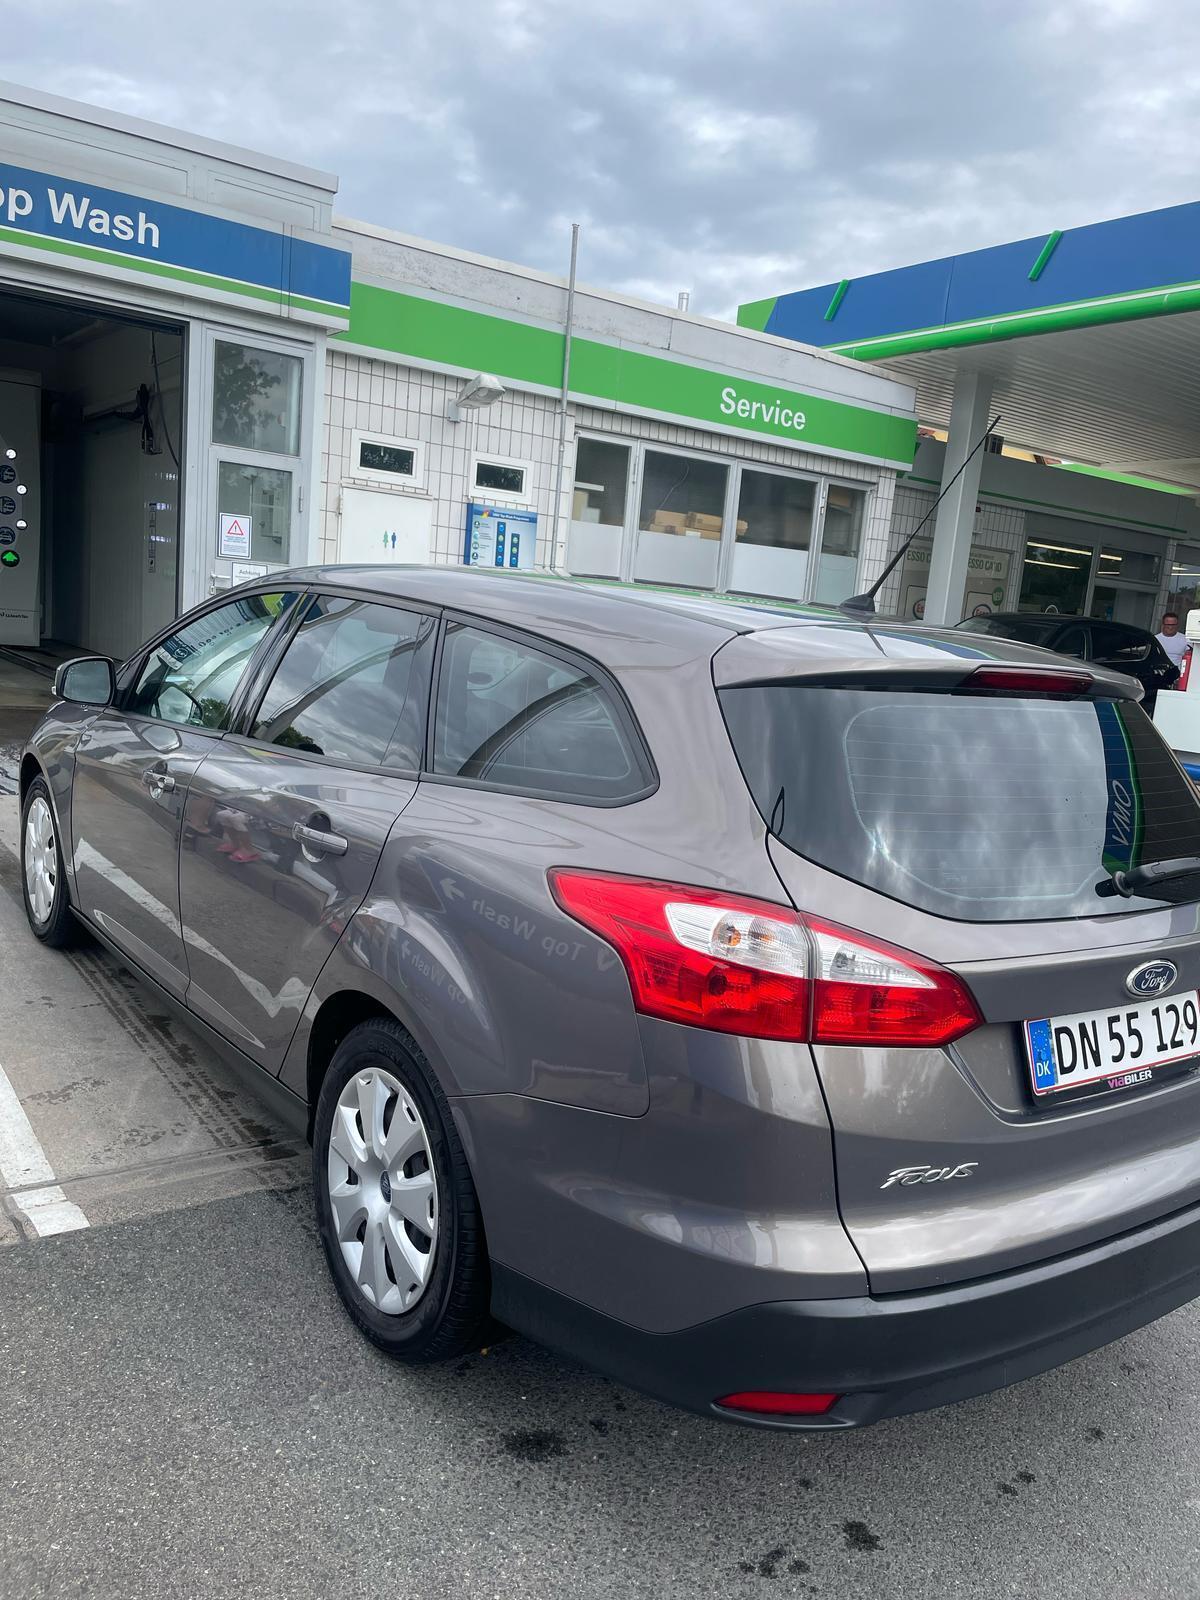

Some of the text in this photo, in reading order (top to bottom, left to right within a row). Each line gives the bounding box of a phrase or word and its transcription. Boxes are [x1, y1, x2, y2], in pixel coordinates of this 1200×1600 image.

[0, 187, 160, 248] p Wash
[720, 387, 806, 430] Service
[1141, 968, 1169, 989] Ford
[1054, 1000, 1198, 1075] DN 55 129
[1036, 1061, 1051, 1077] DK
